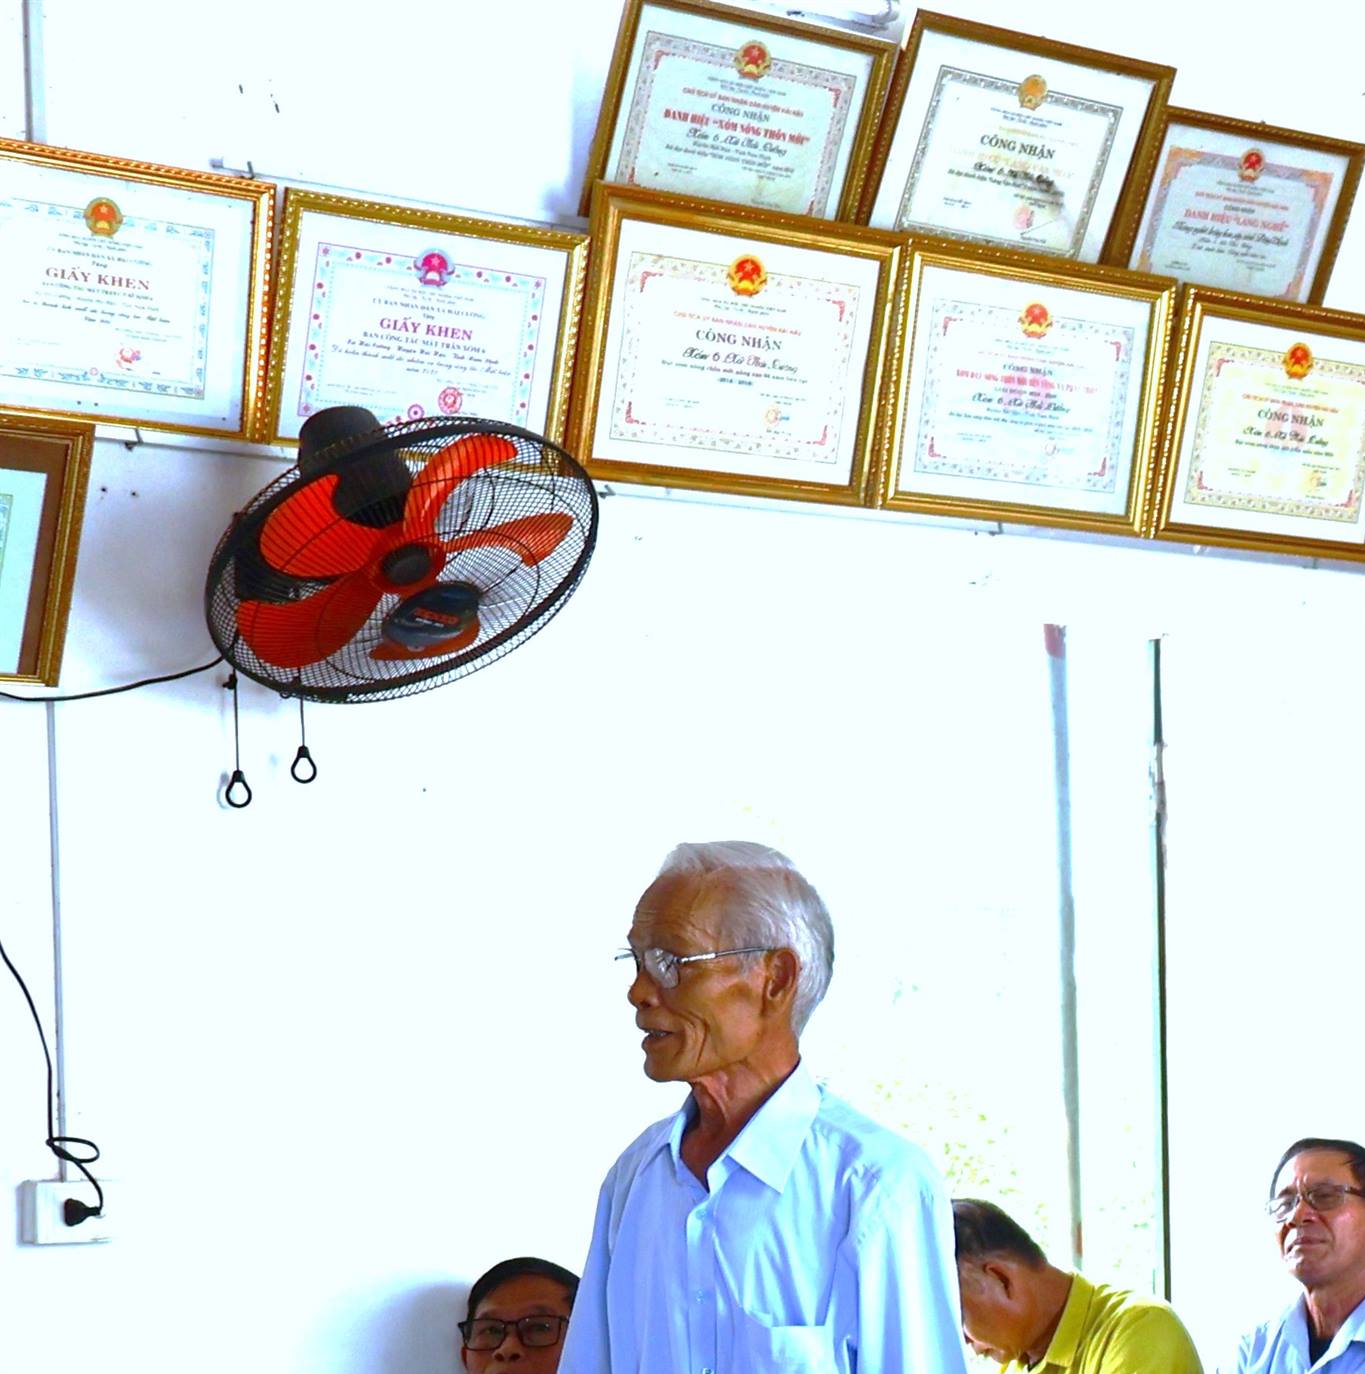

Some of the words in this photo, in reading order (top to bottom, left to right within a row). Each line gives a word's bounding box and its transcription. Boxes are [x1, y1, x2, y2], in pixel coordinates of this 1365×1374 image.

[664, 108, 690, 122] DANH
[711, 103, 741, 117] CÔNG
[742, 109, 770, 123] NHẬN
[980, 134, 1016, 152] CÔNG
[1018, 144, 1056, 160] NHẬN
[45, 266, 92, 283] GIẤY
[97, 273, 150, 290] KHEN
[379, 316, 421, 334] GIẤY
[425, 323, 473, 341] KHEN
[696, 328, 737, 345] CÔNG
[741, 335, 783, 352] NHẬN
[1257, 408, 1290, 423] CÔNG
[1291, 414, 1325, 429] NHẬN
